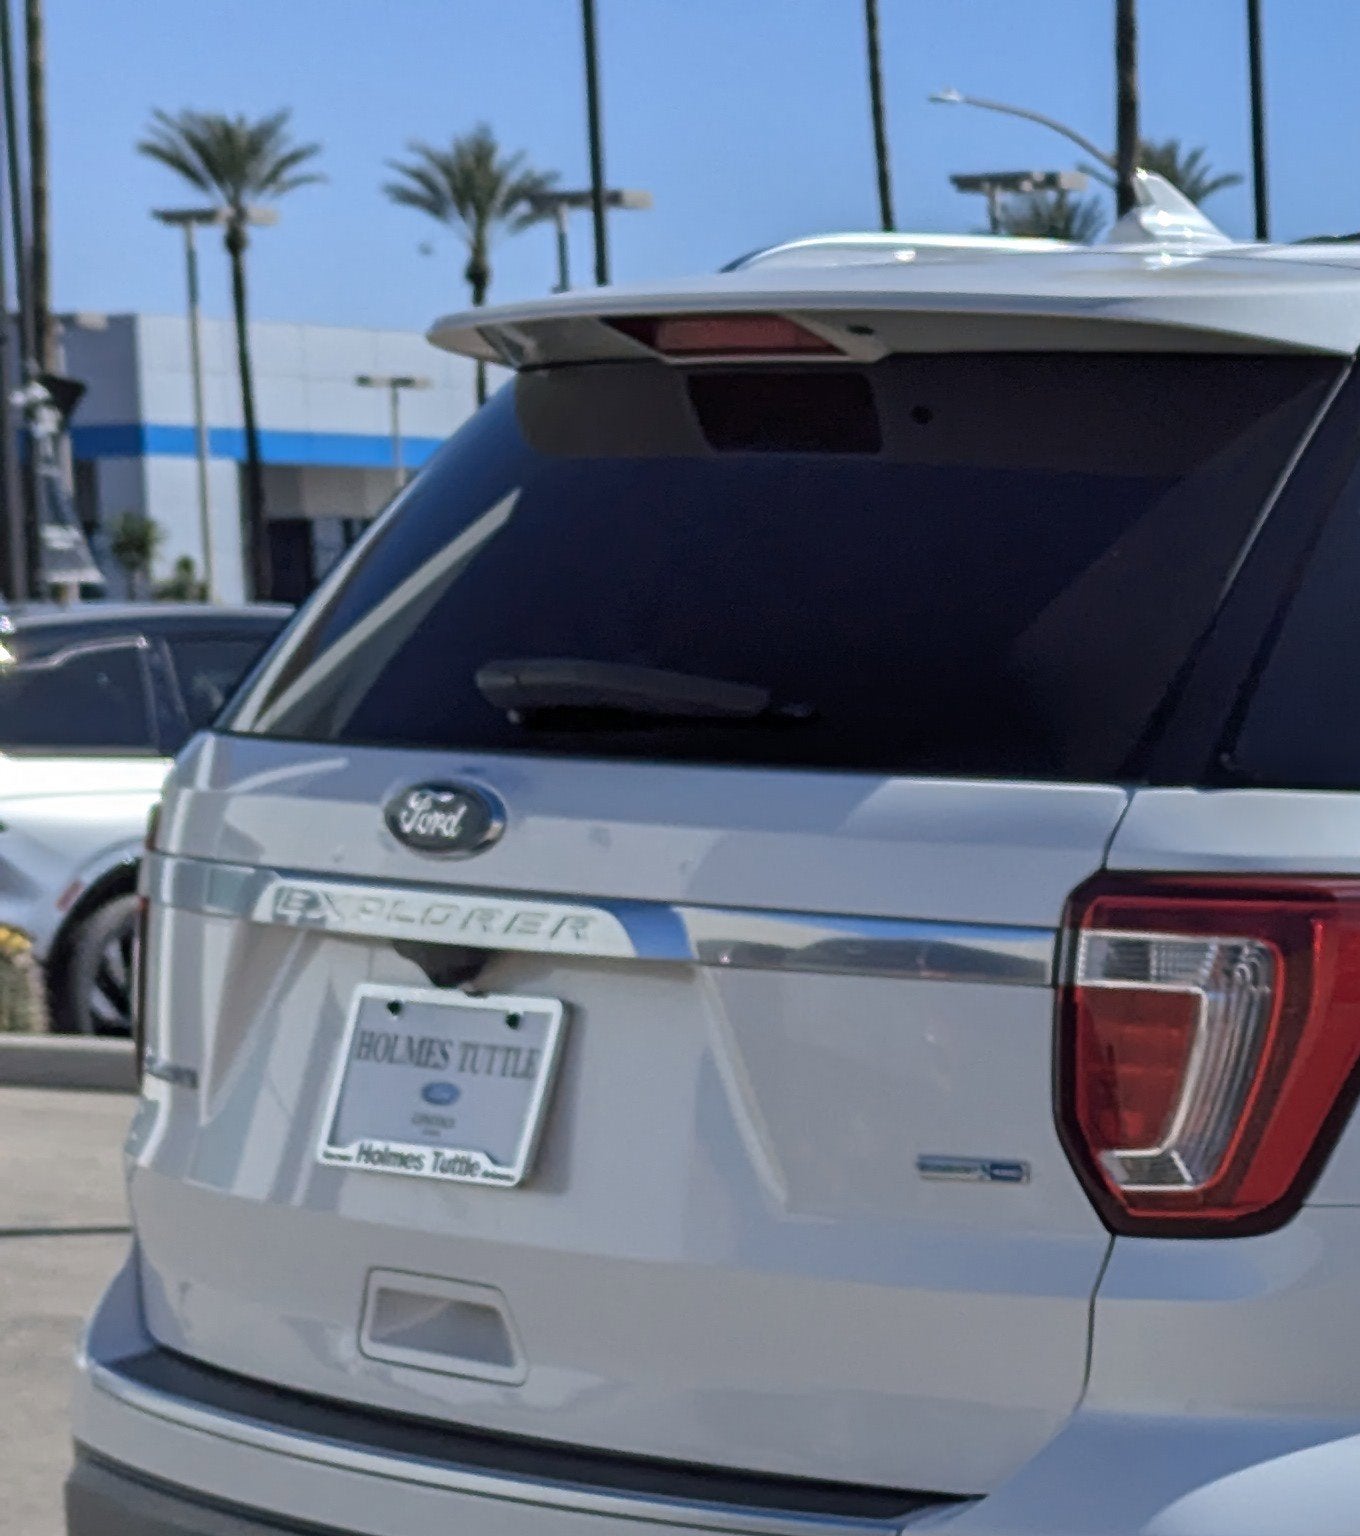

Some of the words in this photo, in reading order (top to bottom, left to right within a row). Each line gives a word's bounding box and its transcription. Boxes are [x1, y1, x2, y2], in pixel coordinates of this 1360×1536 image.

[399, 788, 467, 838] Ford
[353, 1030, 453, 1071] HOLMES
[456, 1041, 542, 1080] TUTTLE
[356, 1142, 425, 1172] Holmes
[432, 1151, 481, 1178] Tuttle
